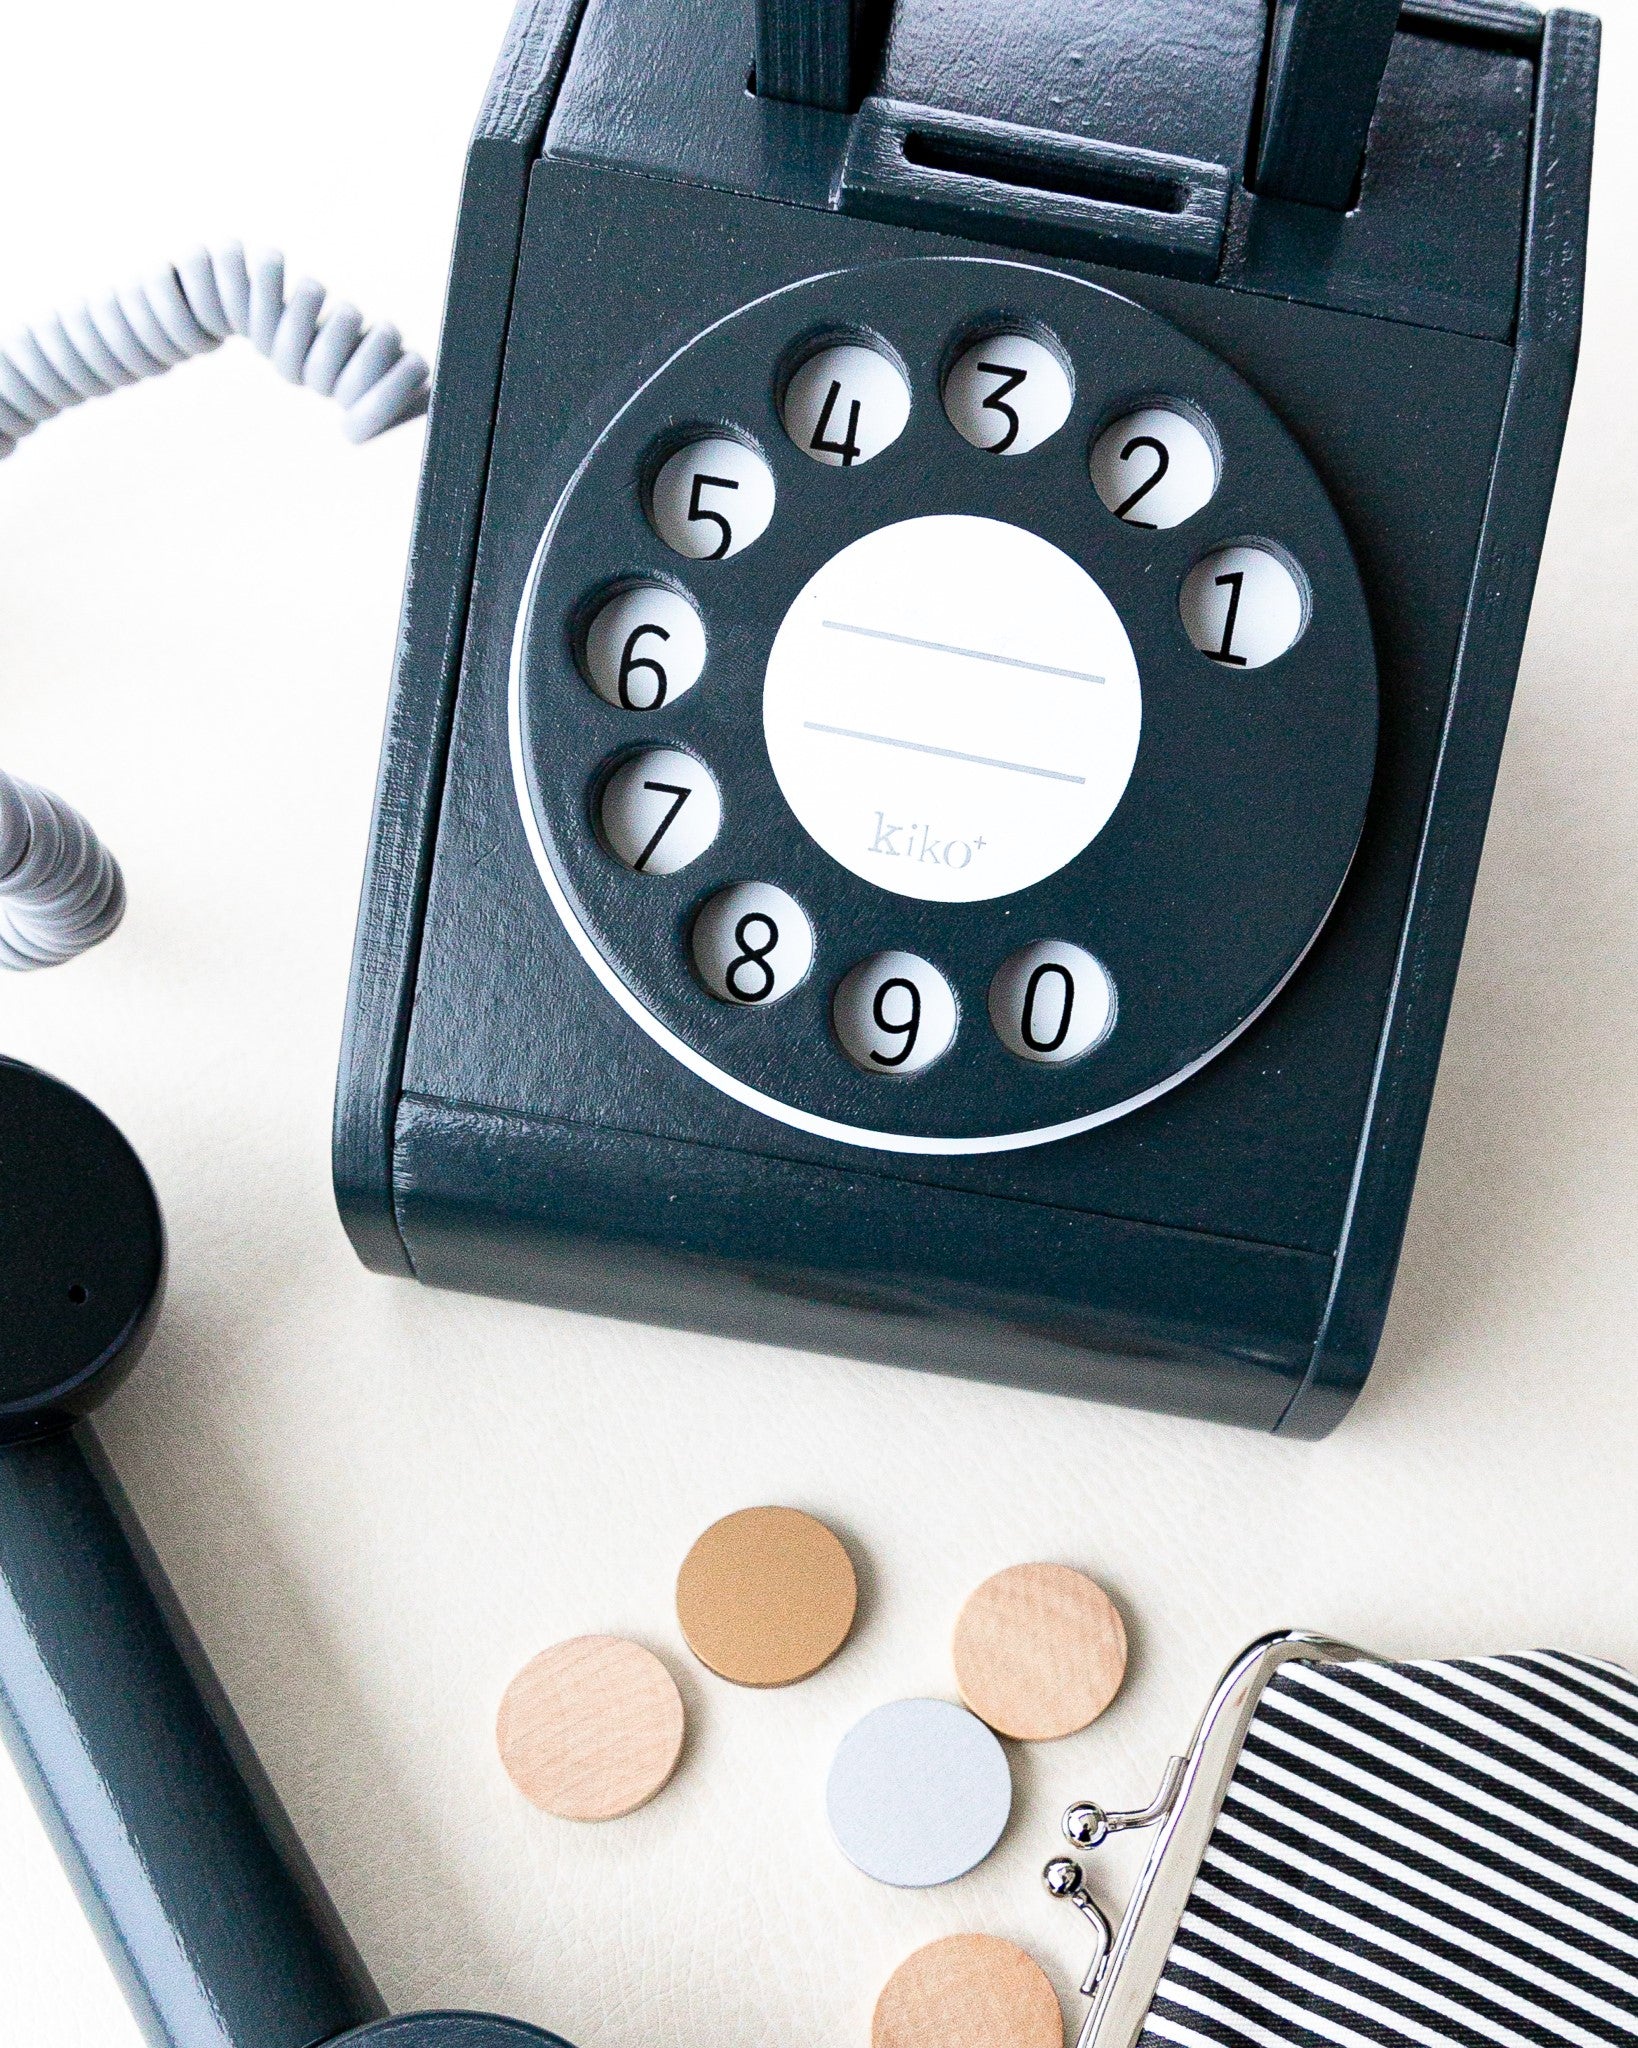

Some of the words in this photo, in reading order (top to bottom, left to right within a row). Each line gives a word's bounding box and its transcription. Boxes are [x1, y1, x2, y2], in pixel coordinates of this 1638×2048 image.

[810, 380, 862, 466] 4
[977, 361, 1028, 454] 3
[686, 473, 740, 560] 5
[1113, 435, 1170, 530] 2
[1201, 572, 1248, 667] 1
[616, 622, 671, 712] 6
[632, 781, 693, 872] 7
[724, 911, 779, 1003] 8
[869, 977, 922, 1067] 9
[1020, 962, 1076, 1053] 0
